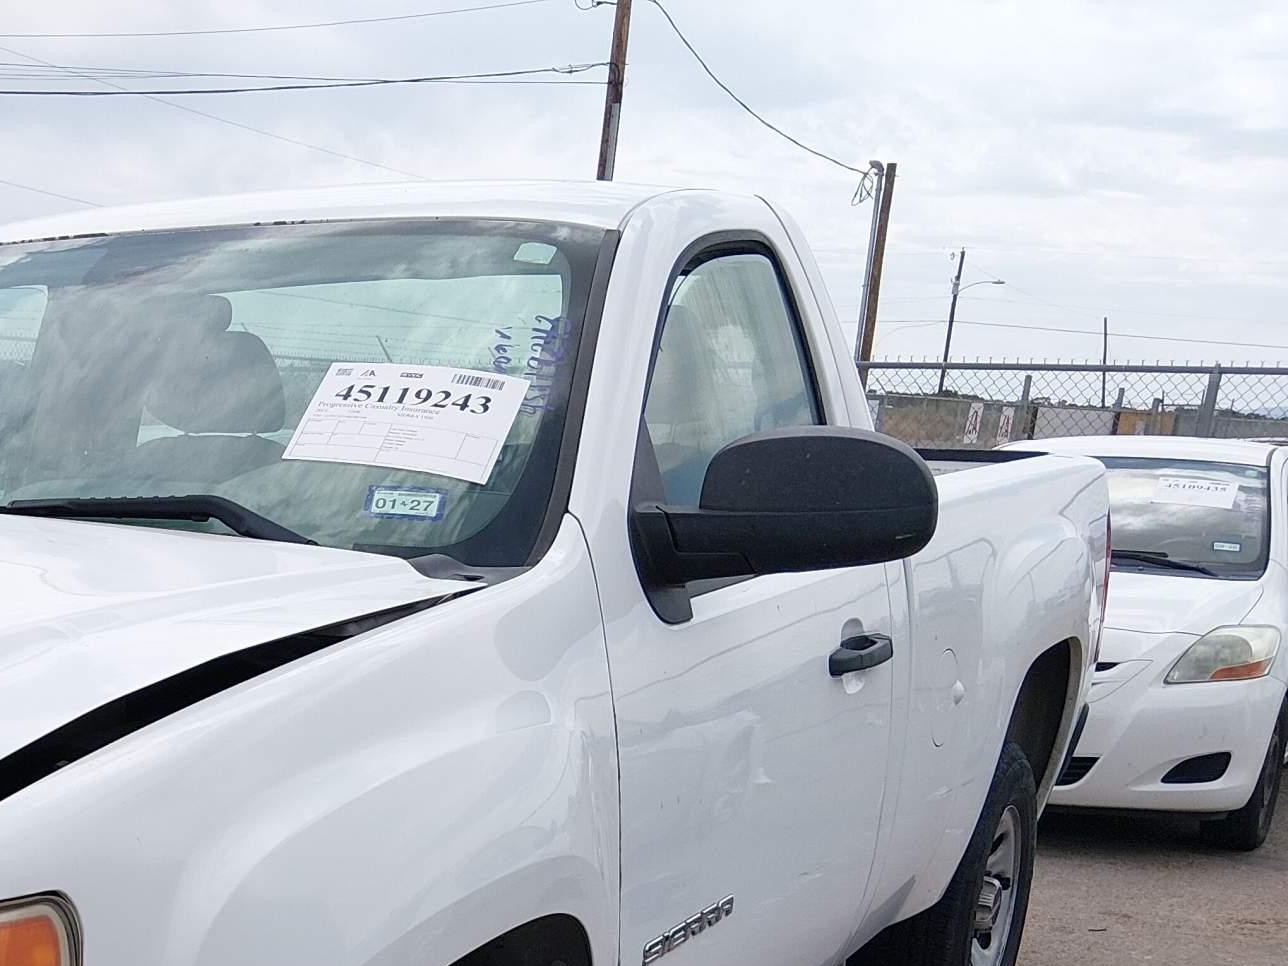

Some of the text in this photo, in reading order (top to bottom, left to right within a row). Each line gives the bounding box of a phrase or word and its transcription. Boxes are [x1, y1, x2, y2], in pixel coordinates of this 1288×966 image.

[318, 401, 363, 409] Progressive
[365, 404, 398, 412] Casualty
[401, 406, 441, 415] Insurance
[335, 383, 492, 415] 45119243
